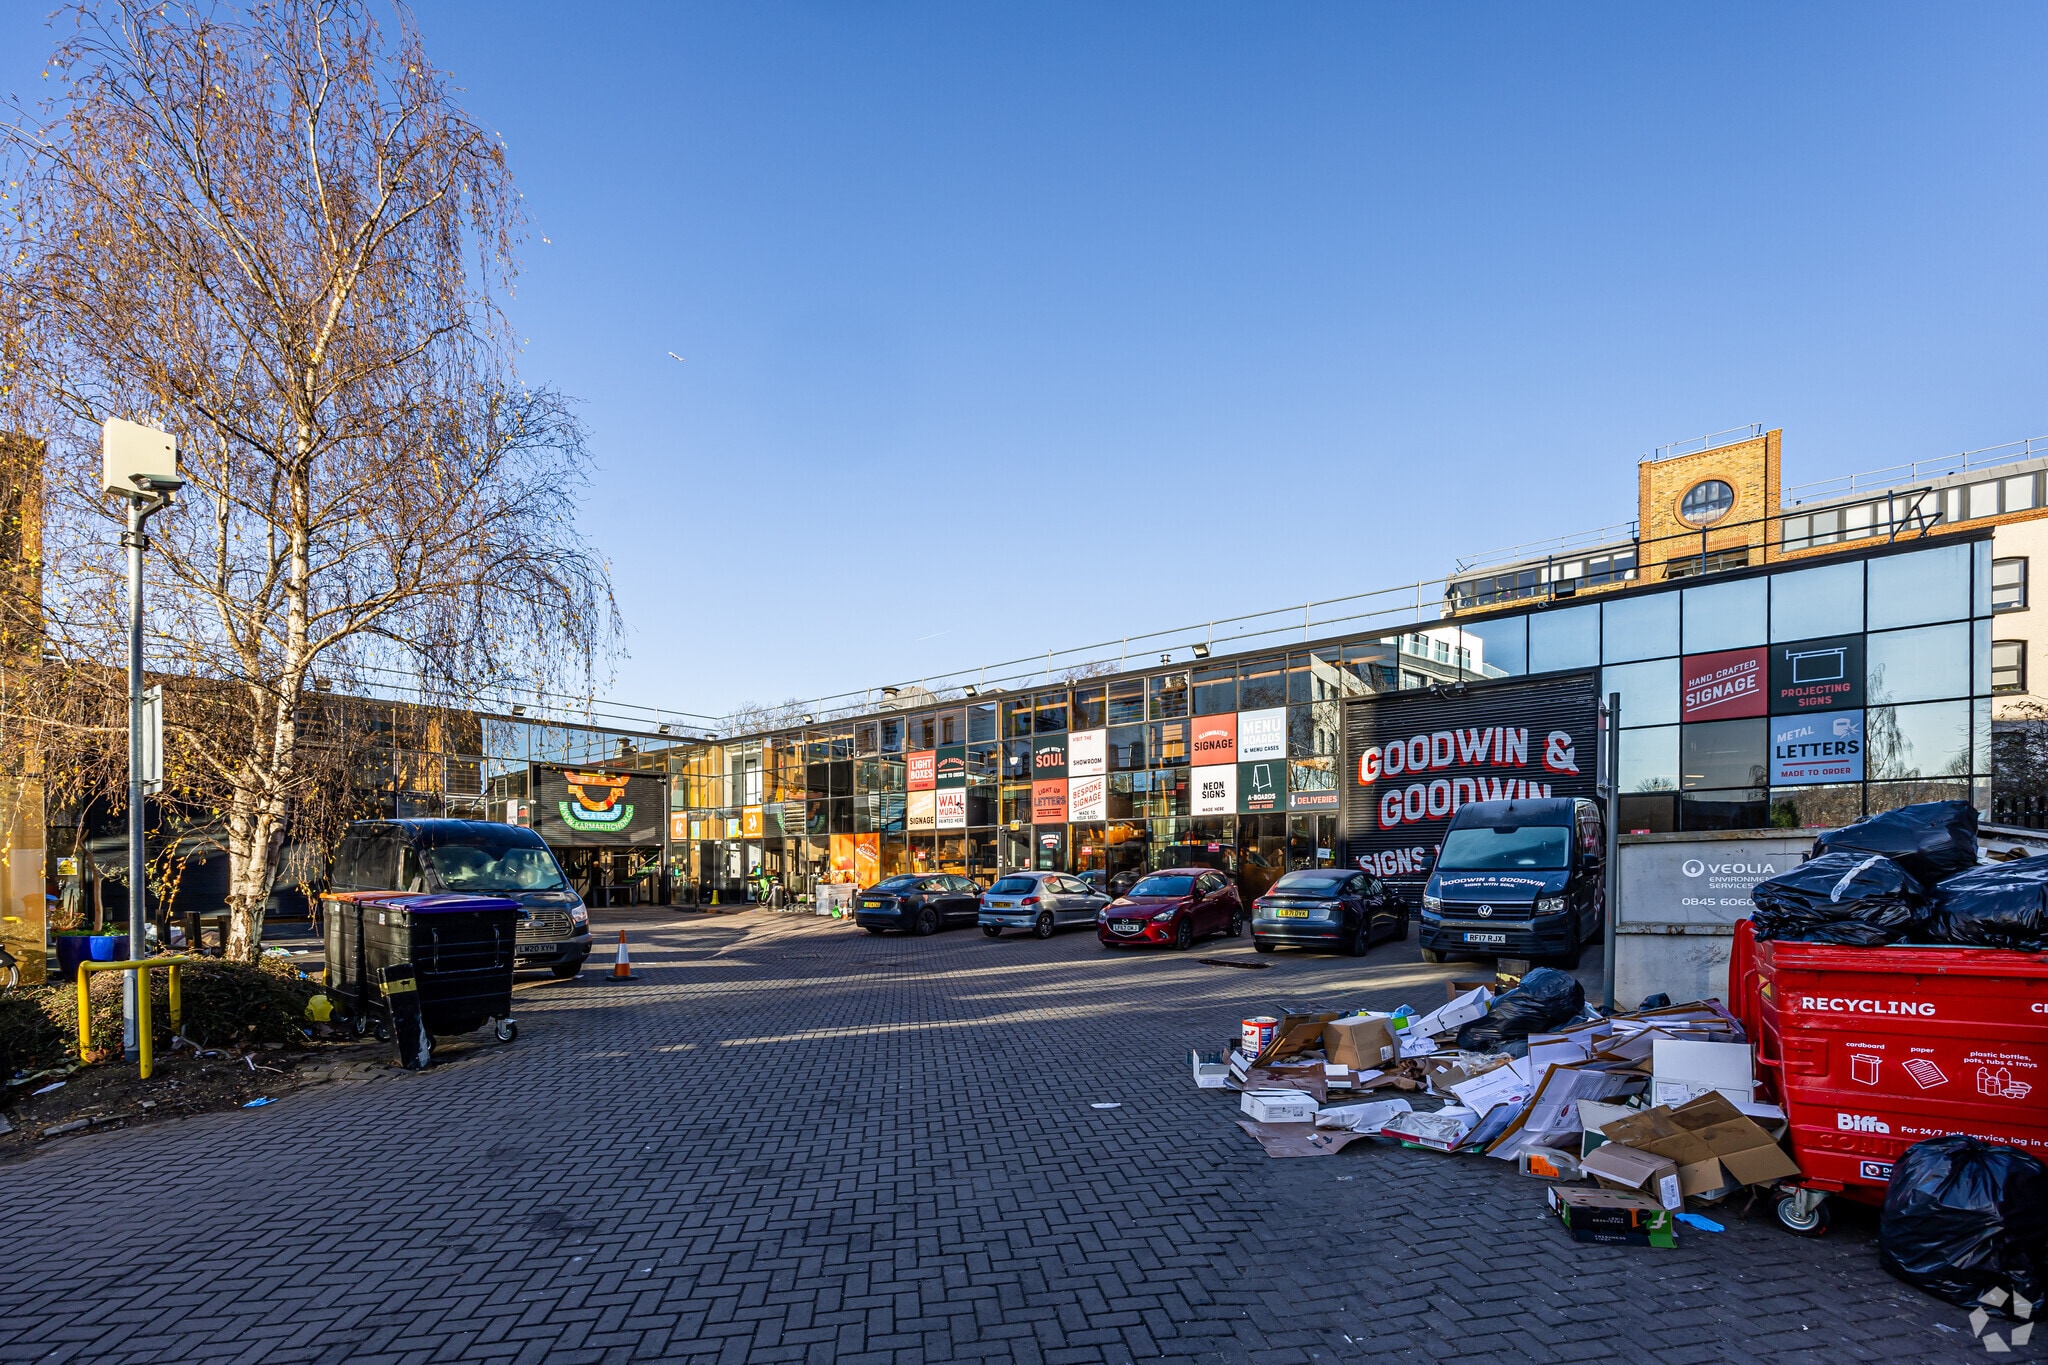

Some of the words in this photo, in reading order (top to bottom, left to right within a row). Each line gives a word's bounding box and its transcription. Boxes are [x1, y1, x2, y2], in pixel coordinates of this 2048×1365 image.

[1688, 673, 1712, 687] HAND
[1716, 659, 1756, 679] CRAFTED
[1686, 674, 1756, 707] SIGNAGE
[1781, 683, 1850, 697] PROJECTING
[1798, 696, 1832, 707] SIGNS
[1243, 720, 1280, 735] MENU
[1243, 733, 1280, 746] BOARDS
[1777, 725, 1814, 743] METAL
[1194, 739, 1233, 751] SIGNAGE
[1776, 740, 1860, 759] LETTERS
[1036, 753, 1064, 768] SOUL
[1358, 727, 1528, 786] GOODWIN
[1542, 730, 1579, 776] &
[912, 759, 932, 770] LIGHT
[910, 769, 933, 780] BOXES
[1781, 769, 1804, 778] MADE
[1822, 767, 1851, 775] ORDER
[1038, 787, 1052, 795] LIGHT
[1072, 782, 1102, 800] BESPOKE
[1203, 781, 1224, 790] NEON
[1073, 792, 1101, 808] SIGNAGE
[1202, 790, 1226, 799] SIGNS
[1298, 796, 1337, 804] DELIVERIES
[938, 795, 964, 807] WALL
[1034, 796, 1066, 807] LETTERS
[1378, 776, 1552, 830] GOODWIN
[939, 807, 964, 816] MURALS
[1708, 864, 1775, 874] VEOLIA
[1441, 877, 1485, 886] GOODWIN
[1500, 877, 1546, 887] GOODWIN
[1802, 996, 1936, 1016] RECYCLING
[1846, 1041, 1885, 1050] cardboard
[1964, 1057, 1984, 1065] pots,
[2000, 1052, 2031, 1061] bottles,
[1838, 1112, 1890, 1134] Biffa
[1920, 1128, 1943, 1136] 24/7
[2010, 1136, 2027, 1146] log
